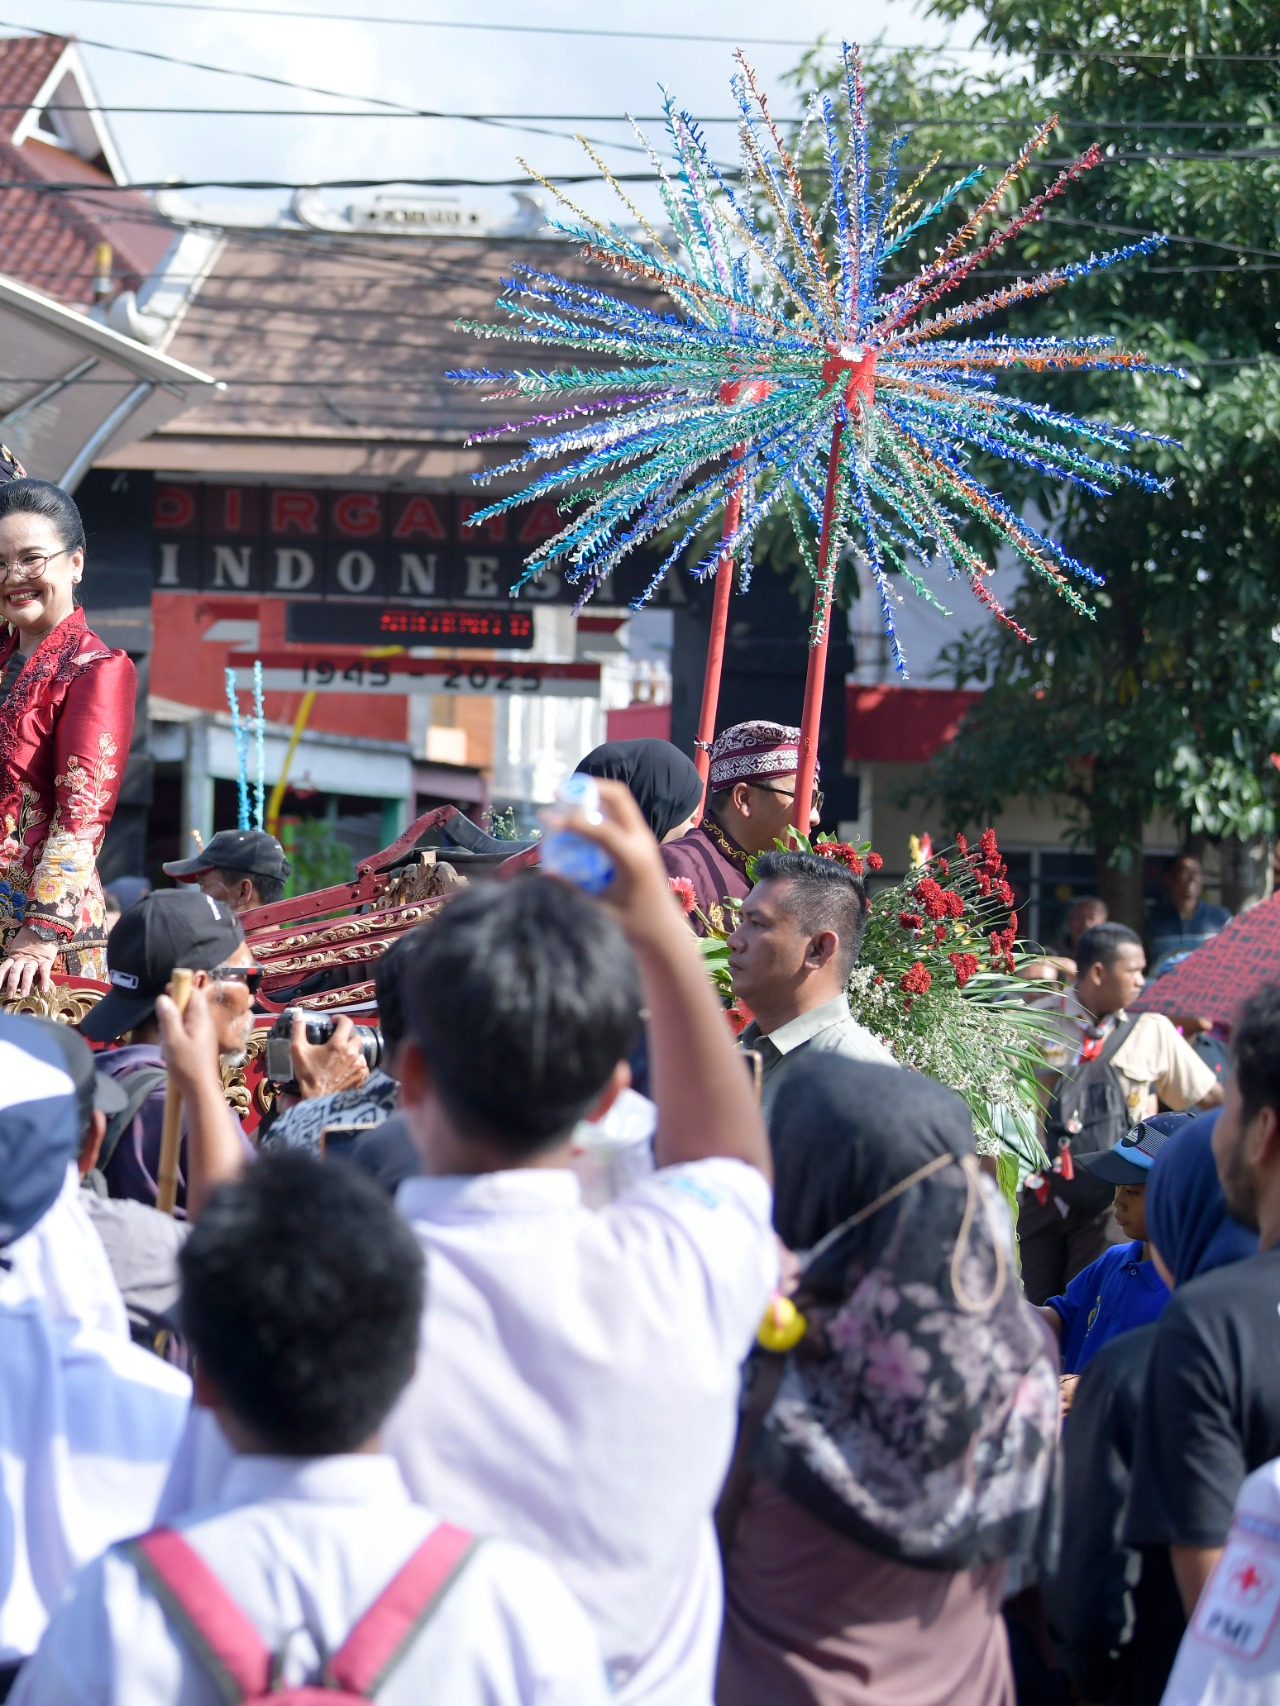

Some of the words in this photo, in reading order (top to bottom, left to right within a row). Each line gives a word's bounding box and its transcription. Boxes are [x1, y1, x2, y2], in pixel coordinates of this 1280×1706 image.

[153, 488, 570, 542] DIRGAHA
[301, 660, 391, 688] 1945
[443, 664, 542, 693] 2025
[1206, 1608, 1254, 1645] PMI
